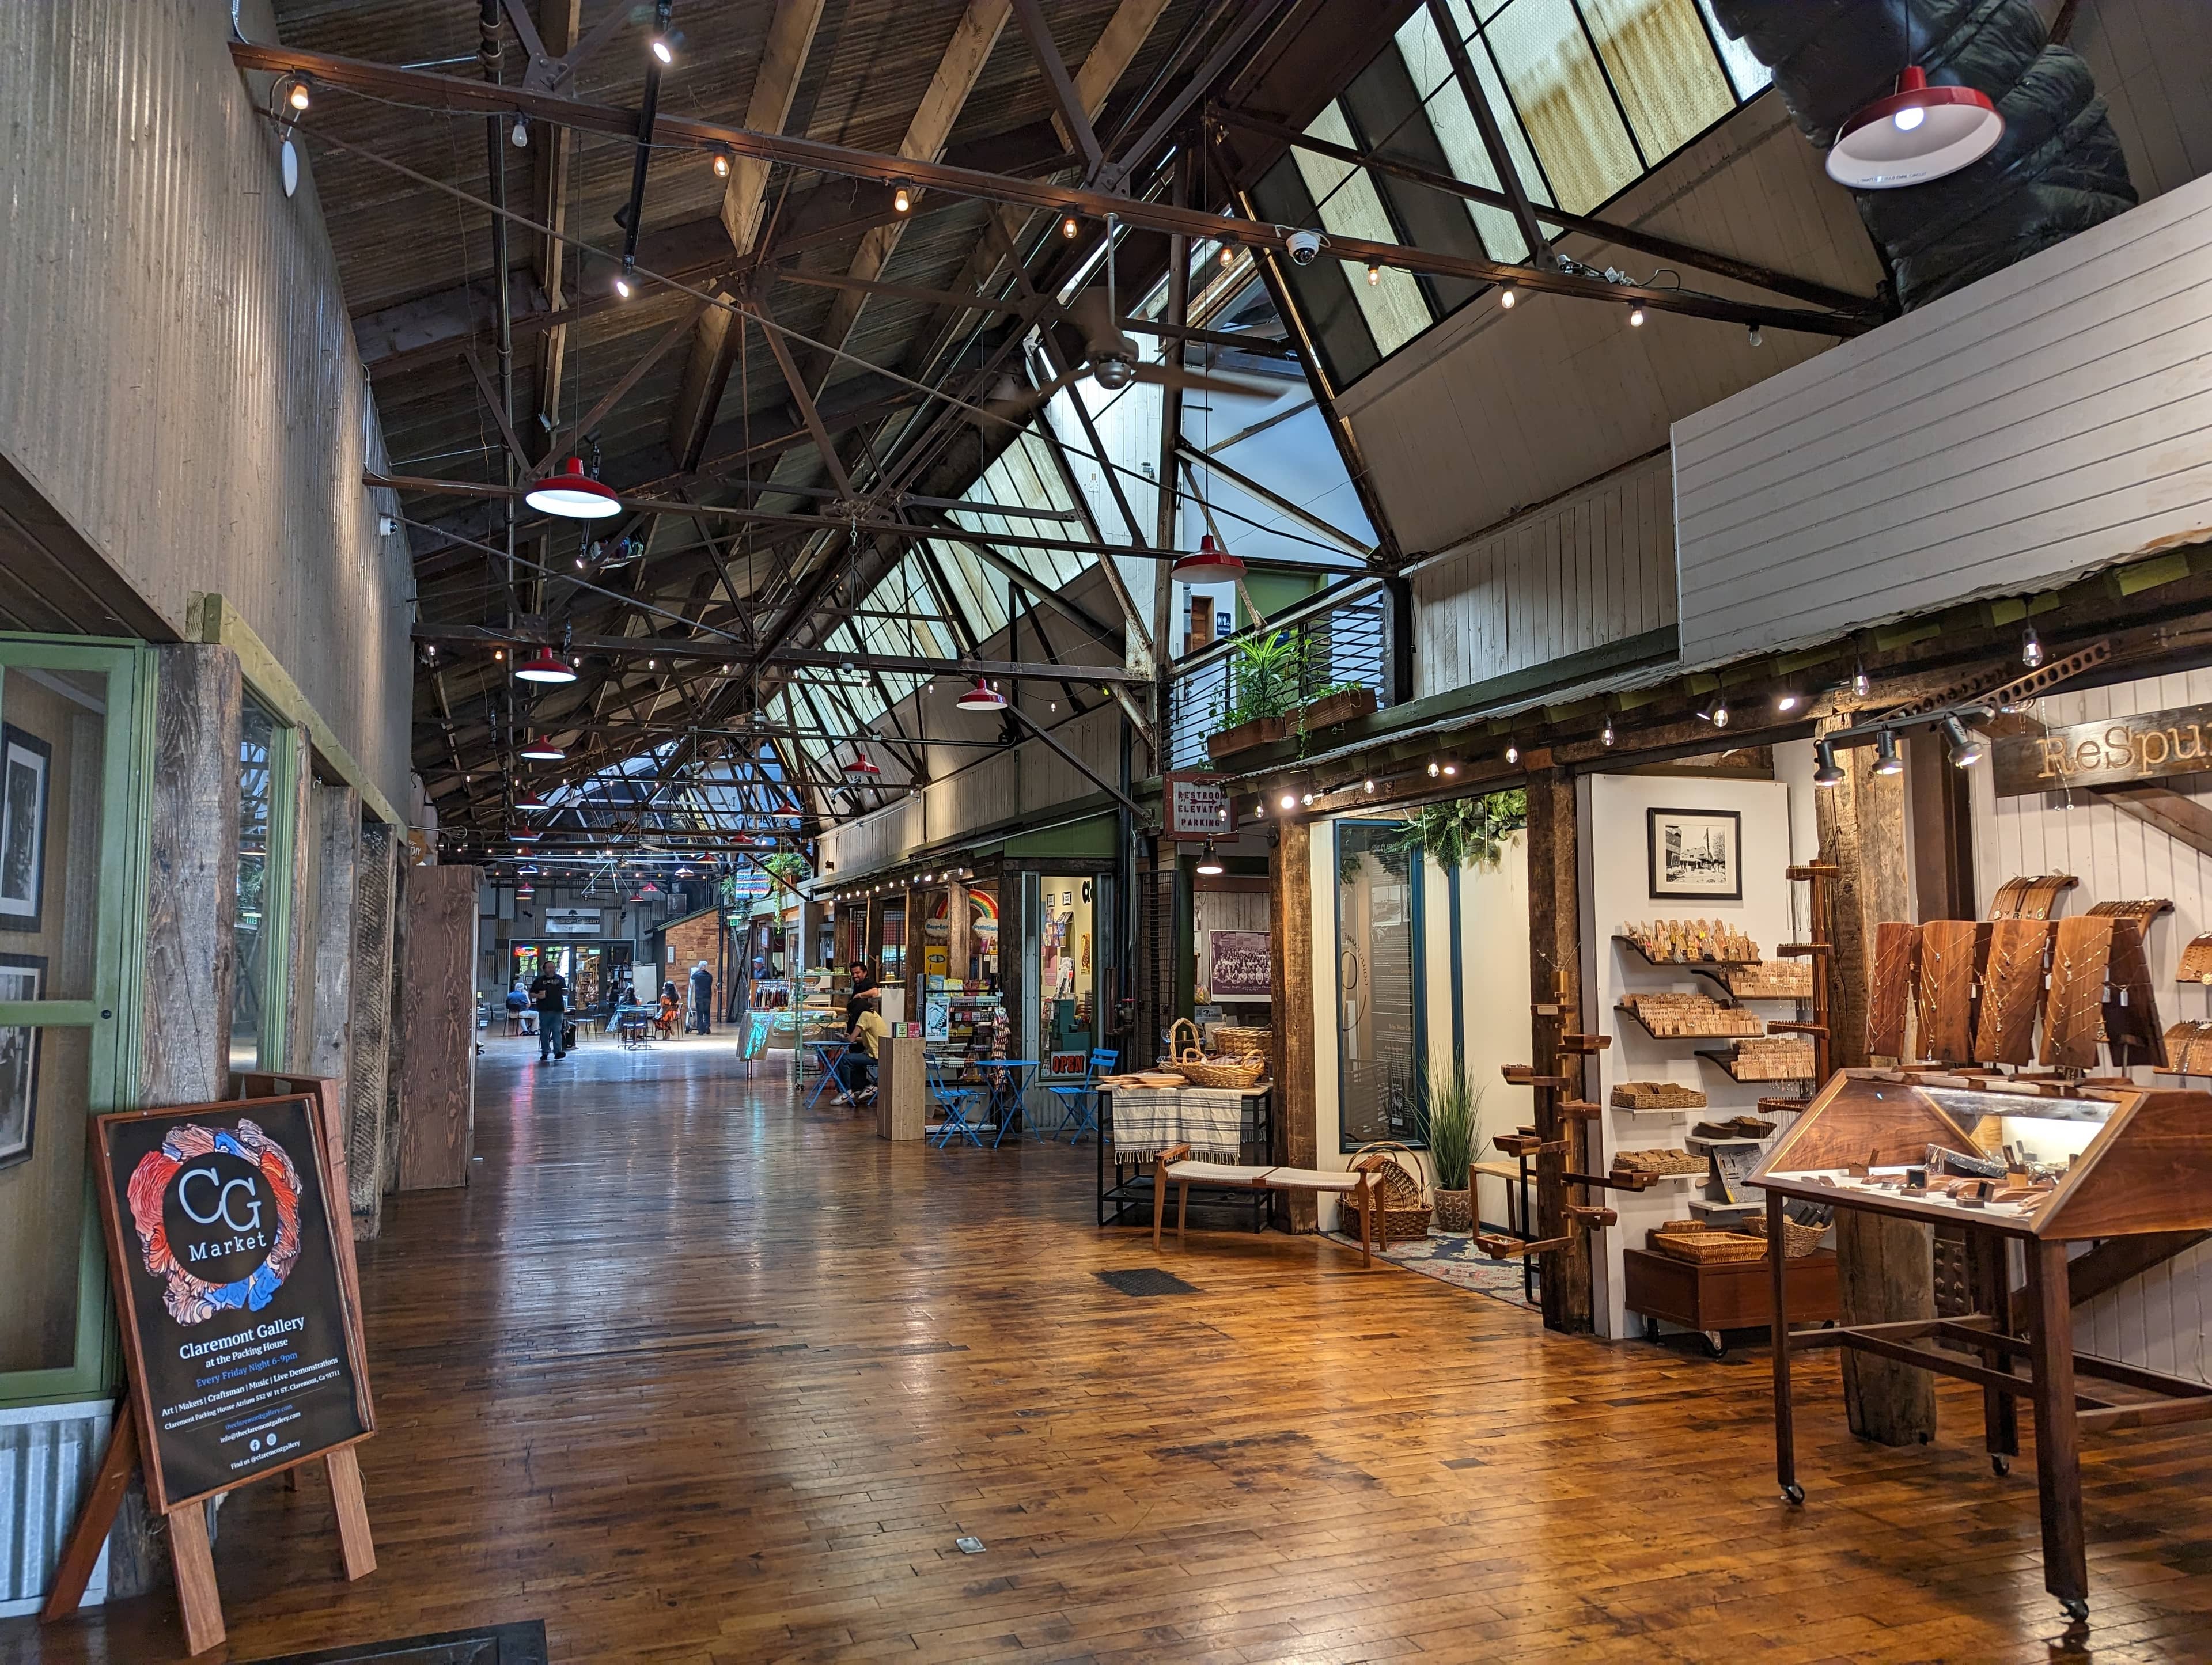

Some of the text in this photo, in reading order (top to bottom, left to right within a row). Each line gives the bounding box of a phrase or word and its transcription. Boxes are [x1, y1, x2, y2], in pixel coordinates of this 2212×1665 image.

[2036, 723, 2212, 777] ReSpu
[1178, 791, 1226, 799] RESTROO
[1178, 805, 1220, 813] ELEVATO
[1181, 818, 1220, 826] PARKING
[1052, 1055, 1084, 1074] OPEN
[179, 1167, 262, 1232] CG
[189, 1231, 267, 1261] Market
[179, 1317, 305, 1359] Claremont Gallery
[205, 1339, 289, 1368] at the Packing House
[196, 1352, 298, 1387] Every Friday Night 6-9pm
[161, 1407, 174, 1417] Art
[179, 1398, 203, 1412] Makers
[207, 1386, 245, 1402] Craftsman
[249, 1378, 270, 1390] Music
[273, 1372, 289, 1383] Live
[289, 1357, 339, 1378] Demonstrations
[165, 1416, 195, 1430] Claremont
[195, 1409, 217, 1421] Packing
[217, 1404, 235, 1413] House
[236, 1398, 255, 1408] Atrium
[290, 1378, 319, 1390] Claremont,
[225, 1404, 293, 1430] theclaremontgallery.com
[219, 1412, 301, 1443] info@theclaremontgallery.com
[230, 1459, 243, 1470] Find
[251, 1440, 301, 1463] @claremontgallery
